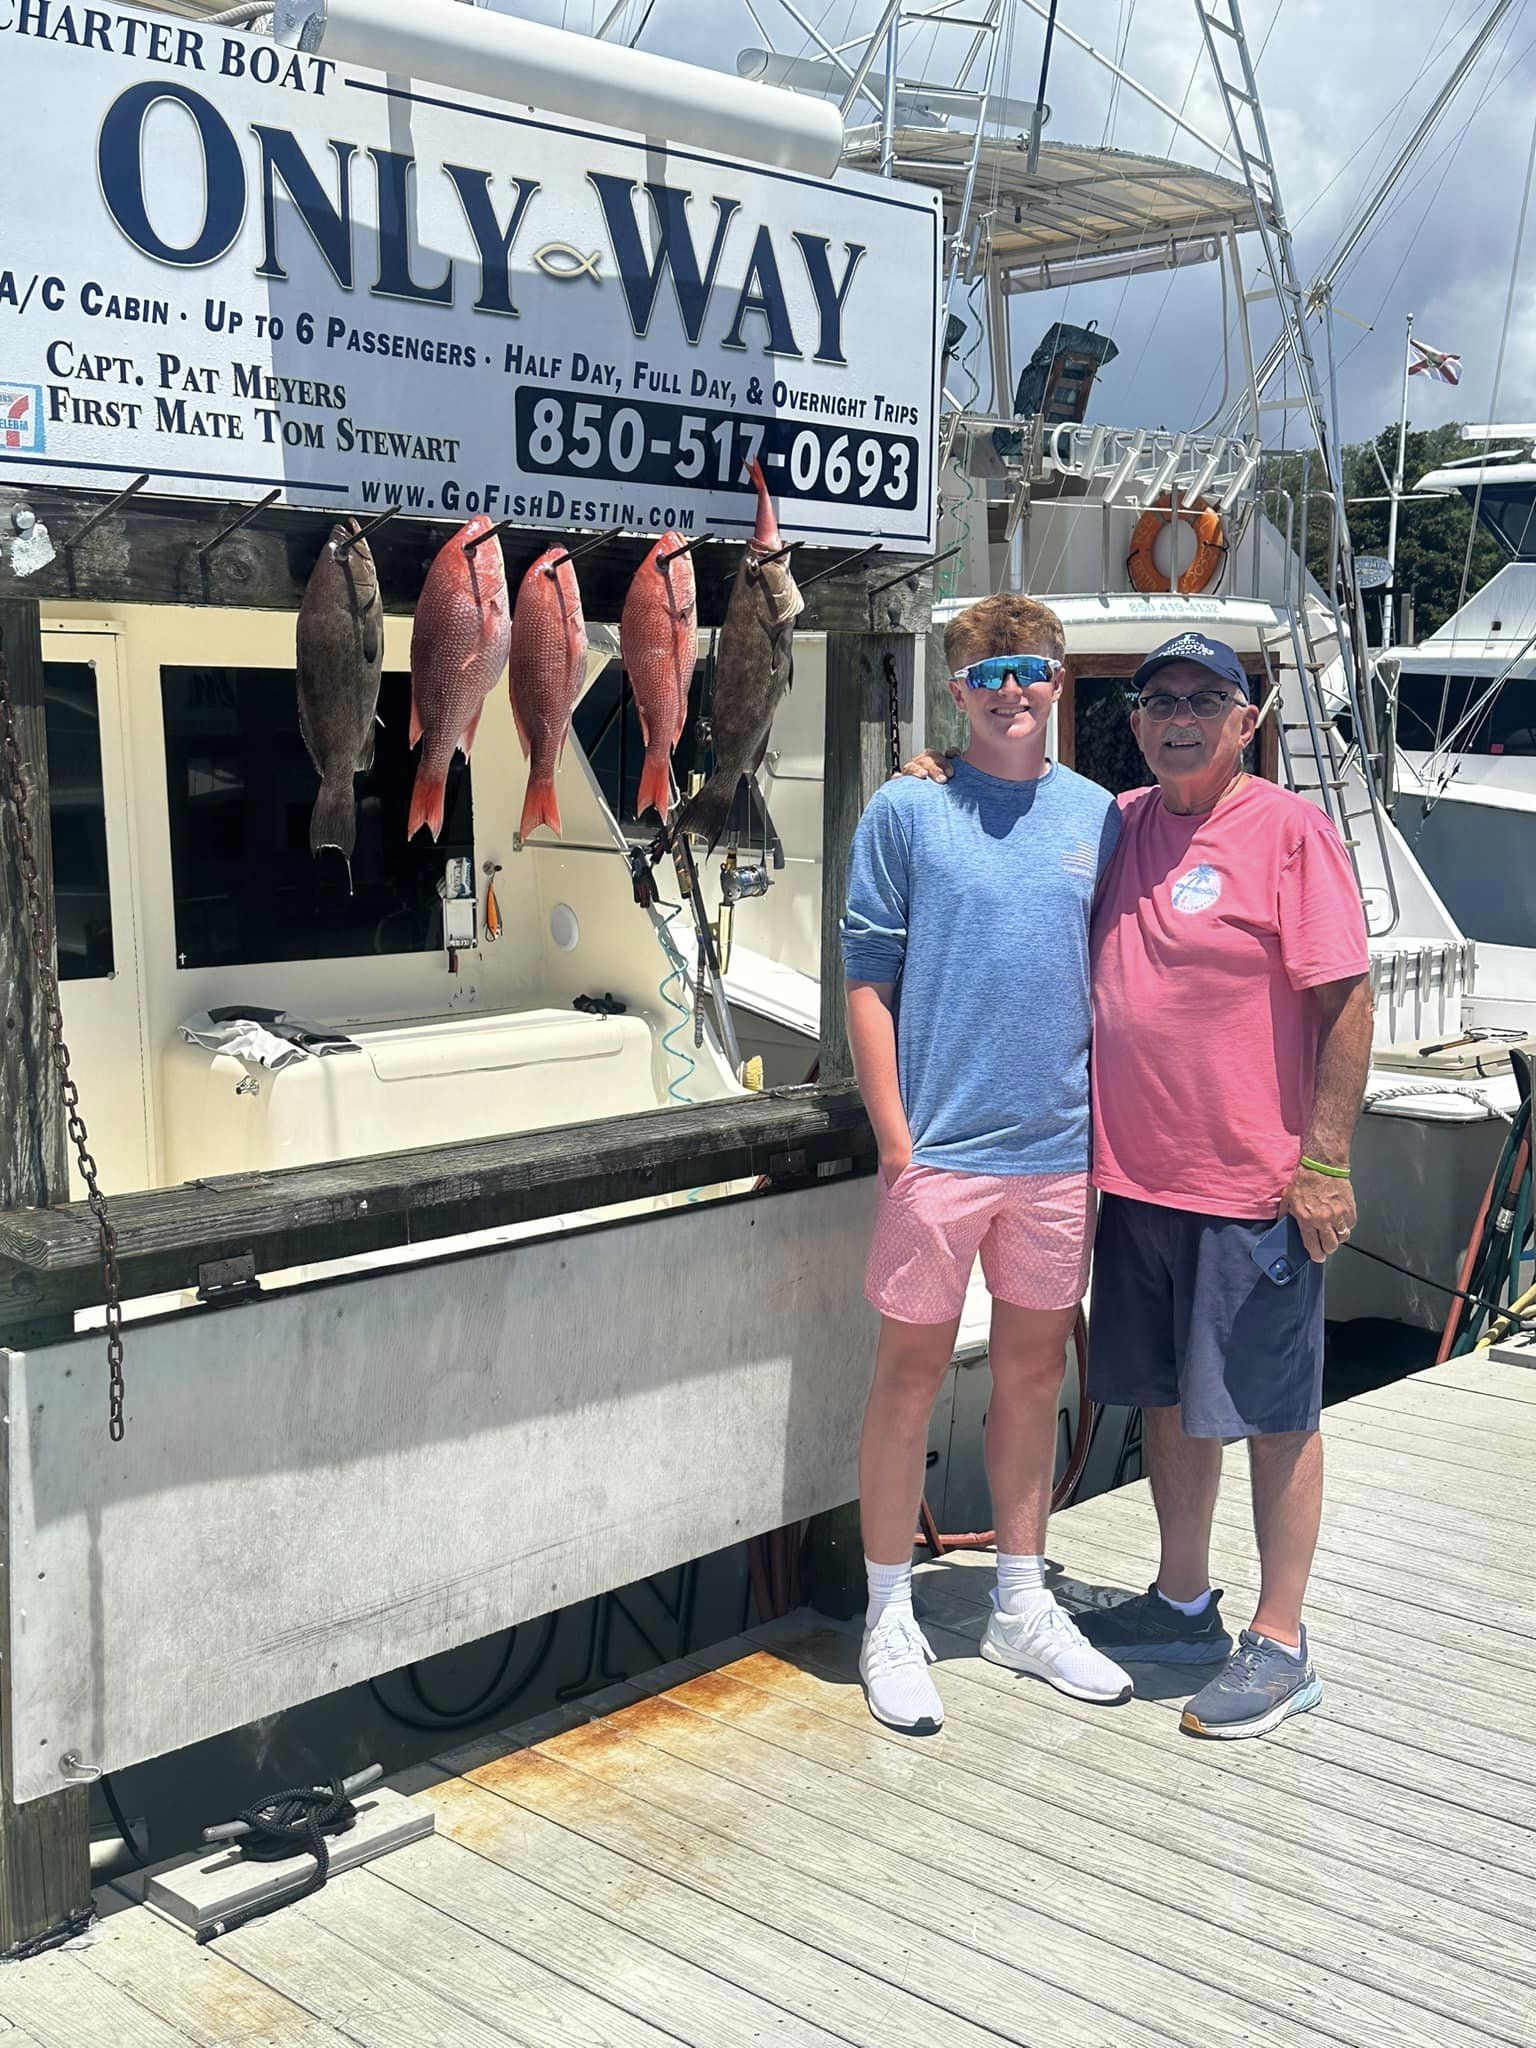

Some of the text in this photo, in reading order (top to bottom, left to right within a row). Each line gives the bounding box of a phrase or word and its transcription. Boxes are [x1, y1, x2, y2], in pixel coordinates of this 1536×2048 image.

[219, 37, 336, 96] BOAT
[97, 79, 868, 366] ONLY WAY
[0, 270, 919, 426] A/C CABIN UP TO 6 PASSENGERS HALF DAY, FULL DAY, & OVERNIGHT TRIPS
[46, 340, 347, 410] CAPT. PAT MEYERS
[46, 385, 461, 464] FIRST MATE TOM STEWART
[528, 397, 911, 502] 850-517-0693
[361, 480, 695, 530] WWW.GOFISHDESTIN.COM
[1128, 602, 1155, 614] 850
